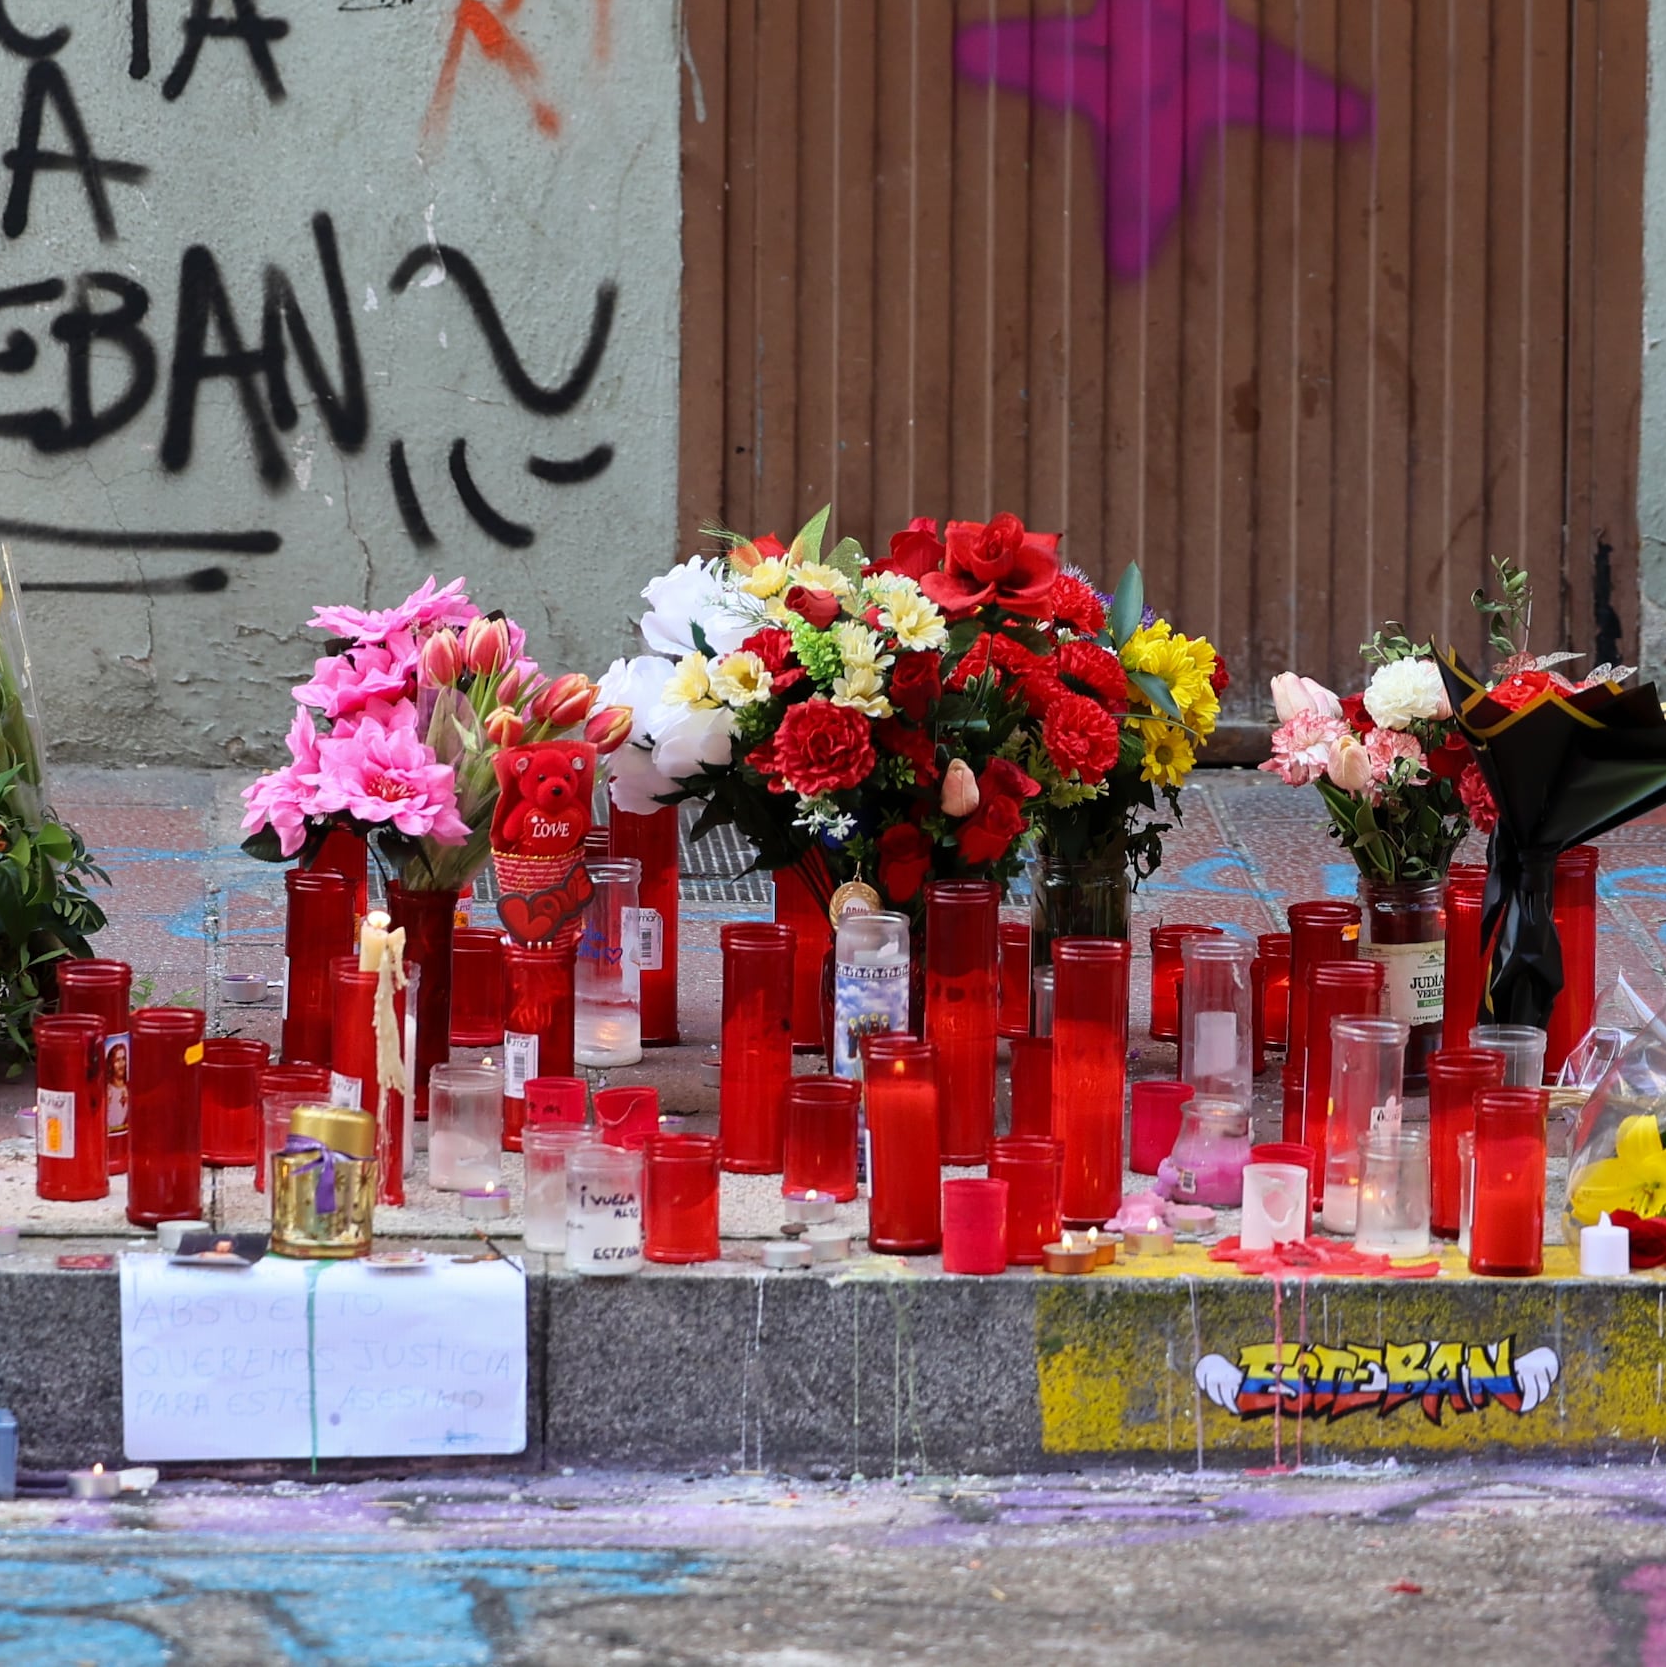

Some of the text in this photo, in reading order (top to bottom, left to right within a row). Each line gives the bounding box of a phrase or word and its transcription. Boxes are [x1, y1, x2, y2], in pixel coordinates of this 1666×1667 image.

[531, 821, 571, 839] LOVE
[130, 1344, 335, 1381] QUEREMOS
[1236, 1334, 1524, 1426] ESTEBAN
[134, 1389, 210, 1422] PARA
